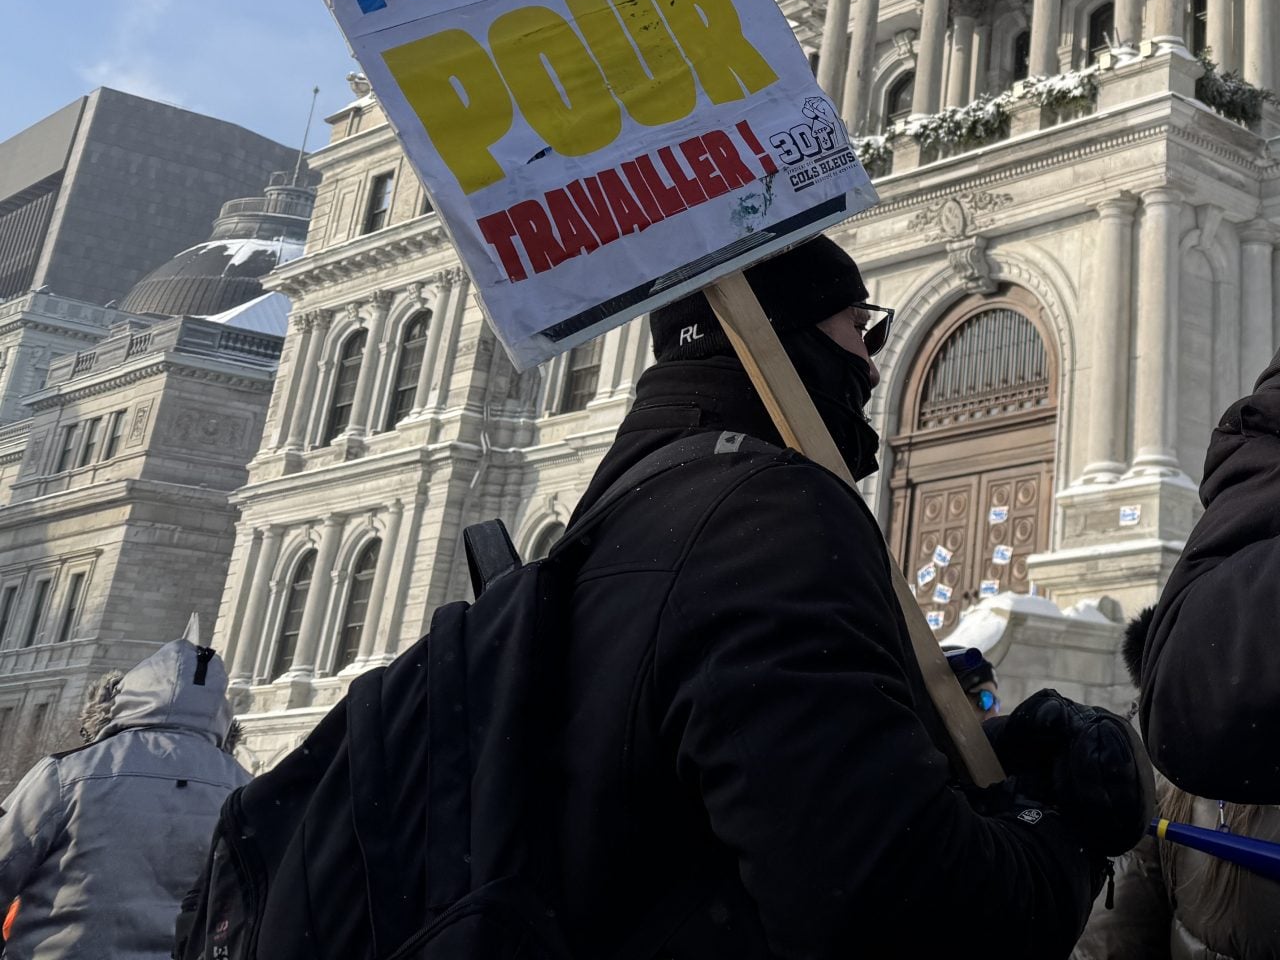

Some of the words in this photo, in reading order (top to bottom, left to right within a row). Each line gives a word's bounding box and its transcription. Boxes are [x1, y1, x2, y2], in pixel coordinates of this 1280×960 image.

[789, 167, 821, 187] COLS
[821, 151, 856, 172] BLEUS
[478, 131, 758, 283] TRAVAILLER
[680, 323, 704, 346] RL
